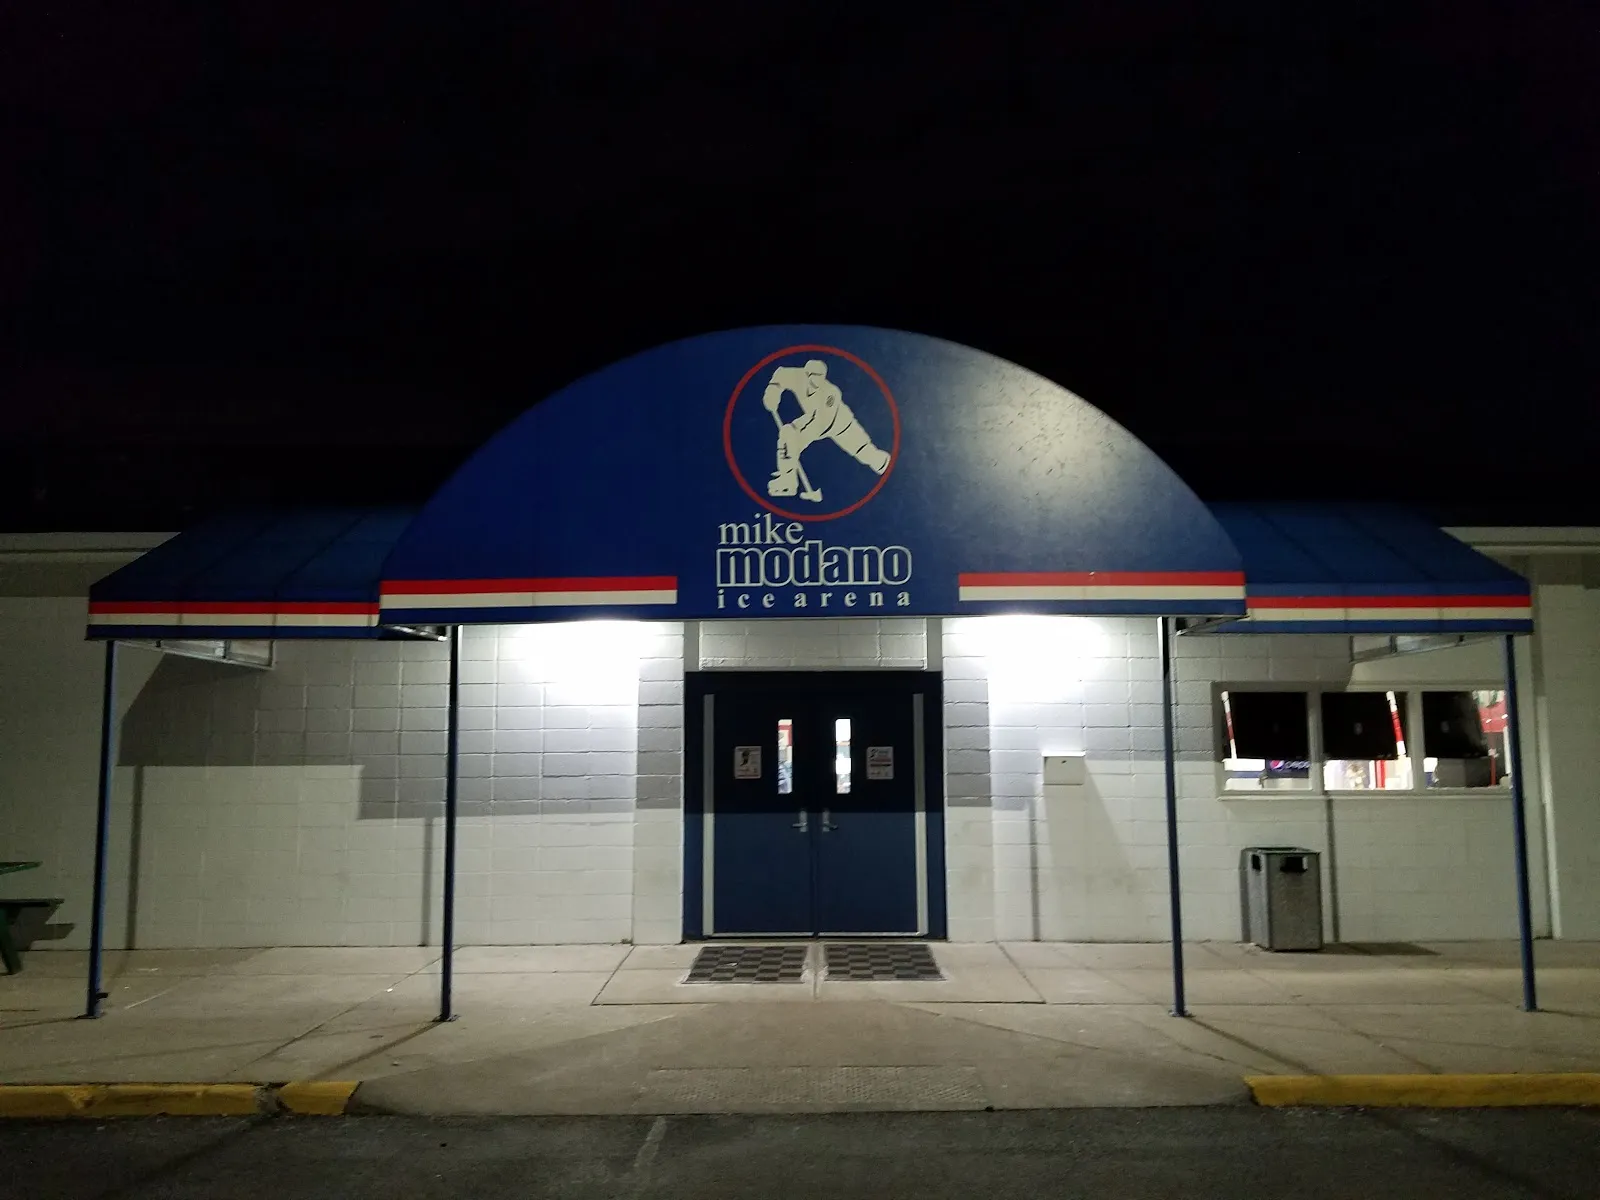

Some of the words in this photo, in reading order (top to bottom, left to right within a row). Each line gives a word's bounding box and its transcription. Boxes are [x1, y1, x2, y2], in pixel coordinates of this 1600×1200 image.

[718, 513, 804, 545] mike
[716, 540, 913, 587] modano
[717, 589, 775, 609] ice
[794, 591, 911, 608] arena
